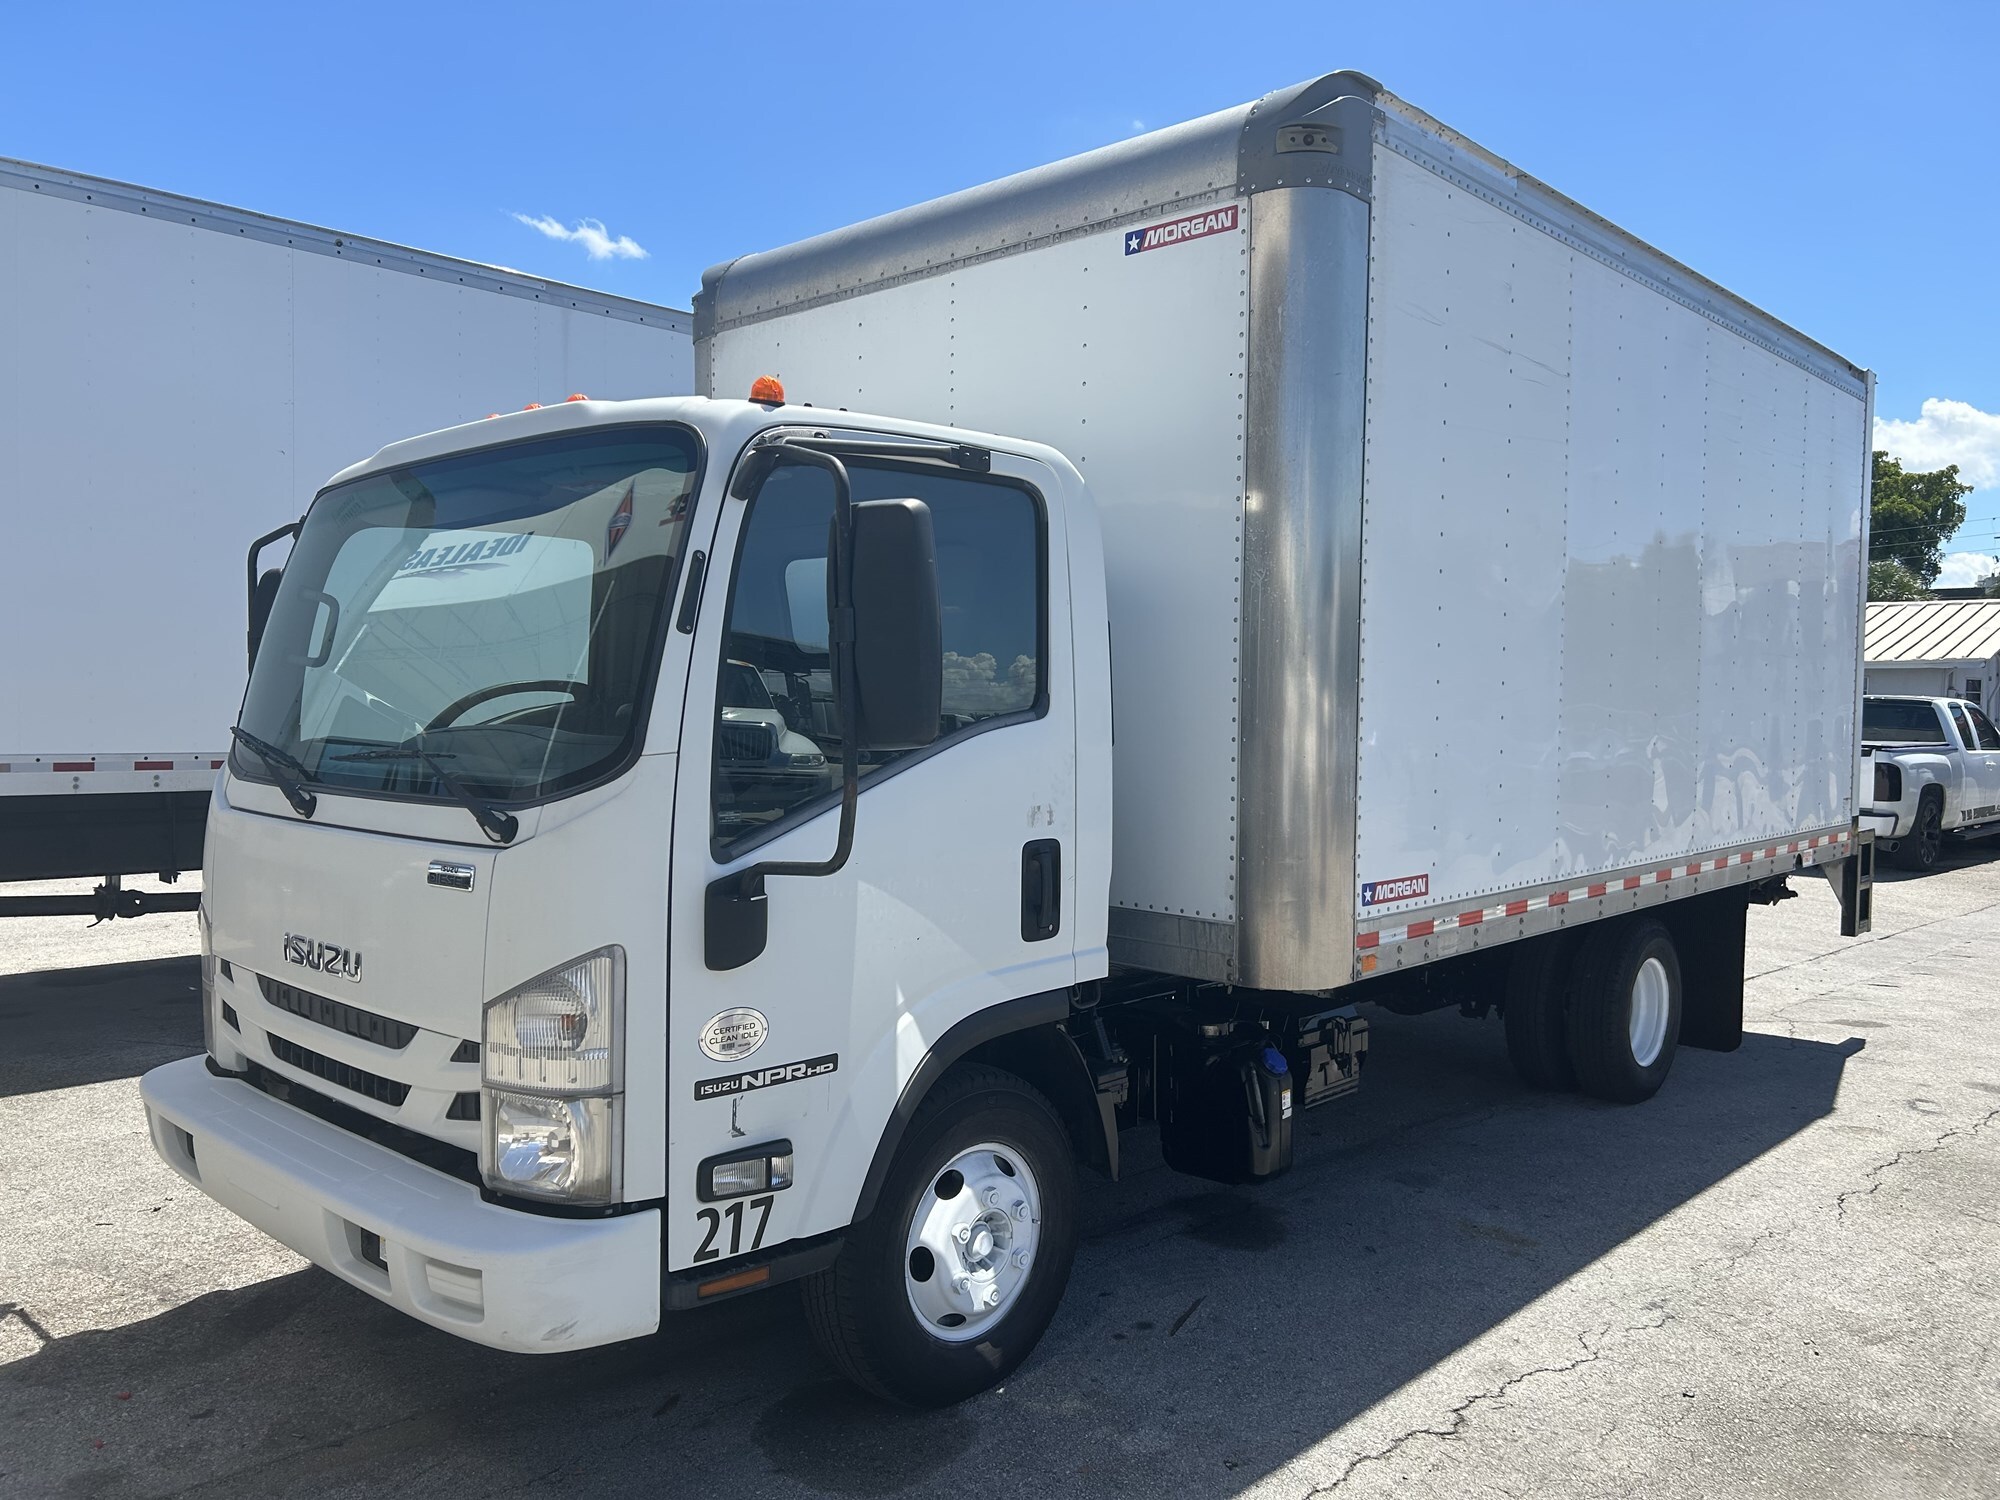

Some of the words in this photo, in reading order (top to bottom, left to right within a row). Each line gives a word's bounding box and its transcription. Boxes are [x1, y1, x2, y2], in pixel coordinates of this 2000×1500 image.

[1144, 209, 1233, 248] MORGAN
[428, 872, 470, 889] DIESE
[1374, 877, 1426, 901] MORGAN
[284, 932, 362, 983] ISUZU
[709, 1034, 738, 1045] CLEAN
[741, 1030, 760, 1040] IDLE
[713, 1022, 756, 1036] CERTIFIED
[700, 1079, 739, 1095] ISUZU
[693, 1194, 774, 1263] 217
